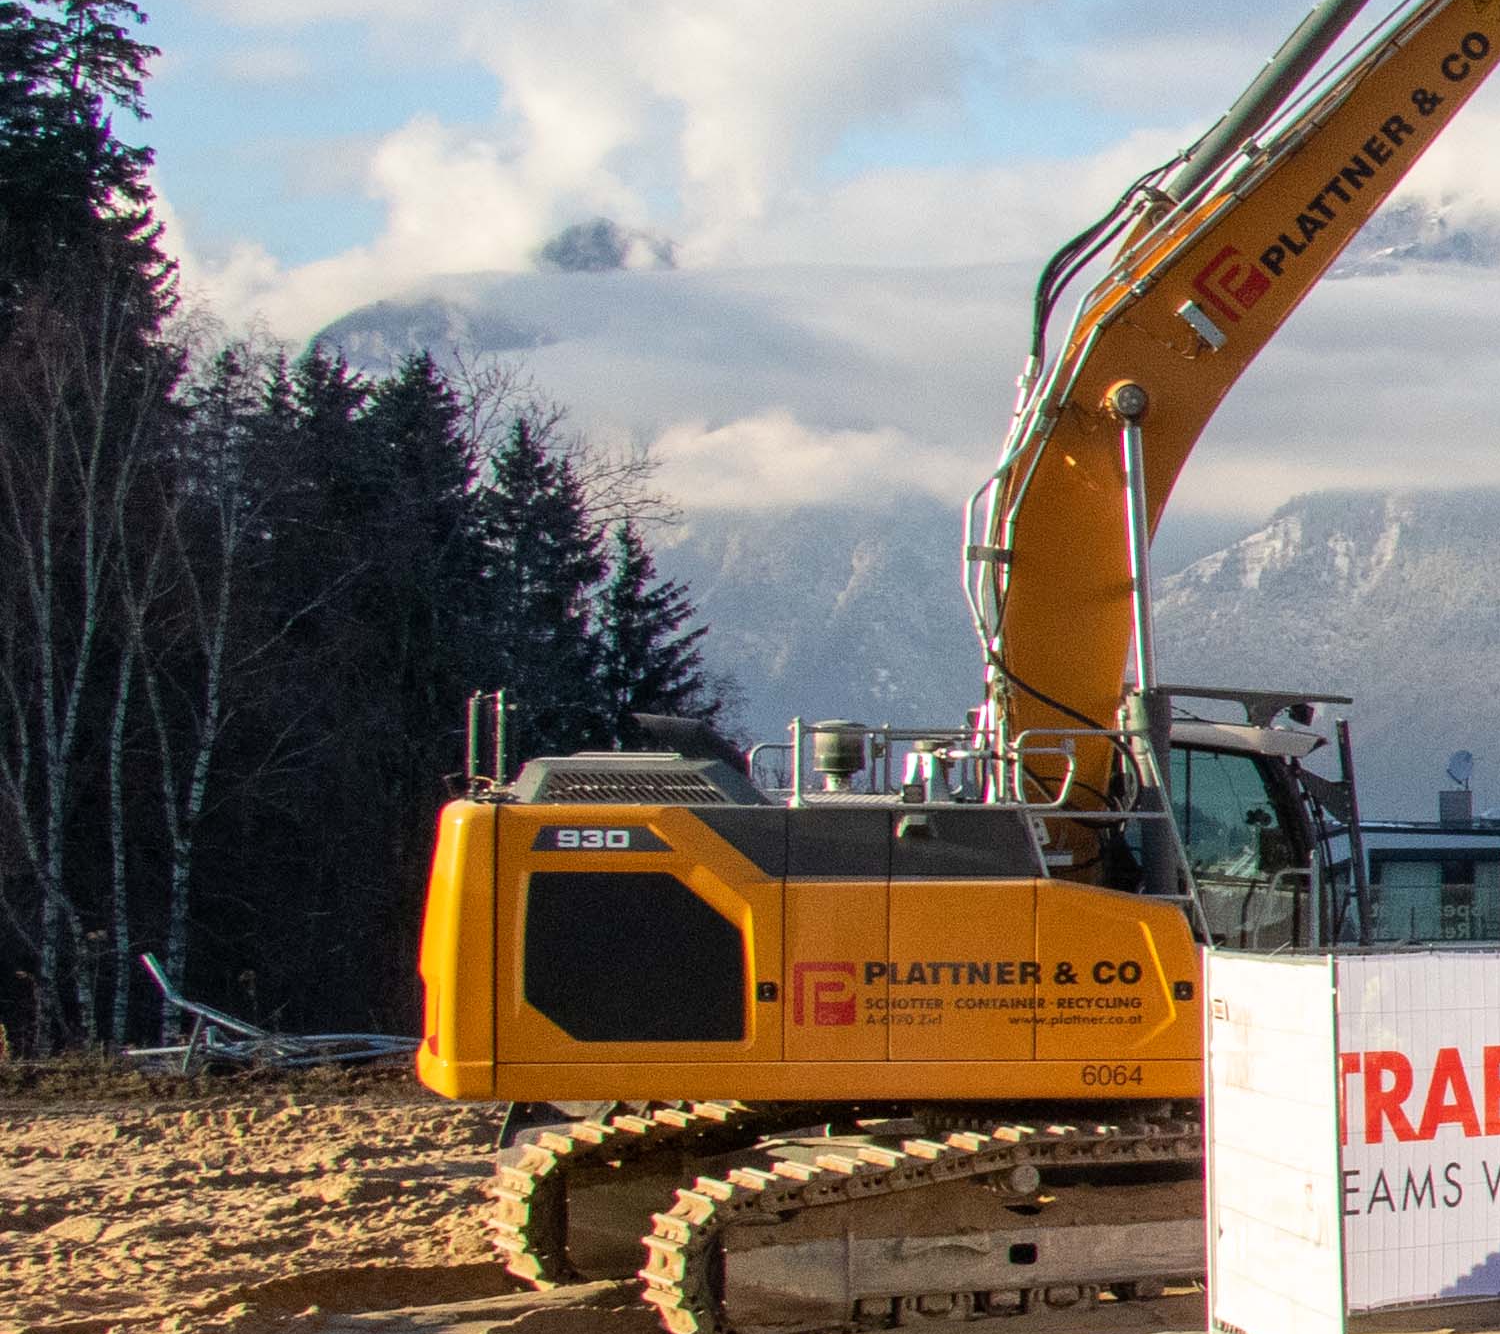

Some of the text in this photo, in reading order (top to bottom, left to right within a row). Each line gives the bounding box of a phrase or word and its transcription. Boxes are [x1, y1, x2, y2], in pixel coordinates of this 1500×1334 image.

[1259, 30, 1490, 276] PLATTNER & CO
[557, 829, 630, 848] 930
[864, 960, 1143, 986] PLATTNER & CO
[865, 996, 1143, 1010] SCHOTTER CONTAINER RECYCLING
[1081, 1065, 1144, 1087] 6064
[1342, 1161, 1463, 1216] EAMS
